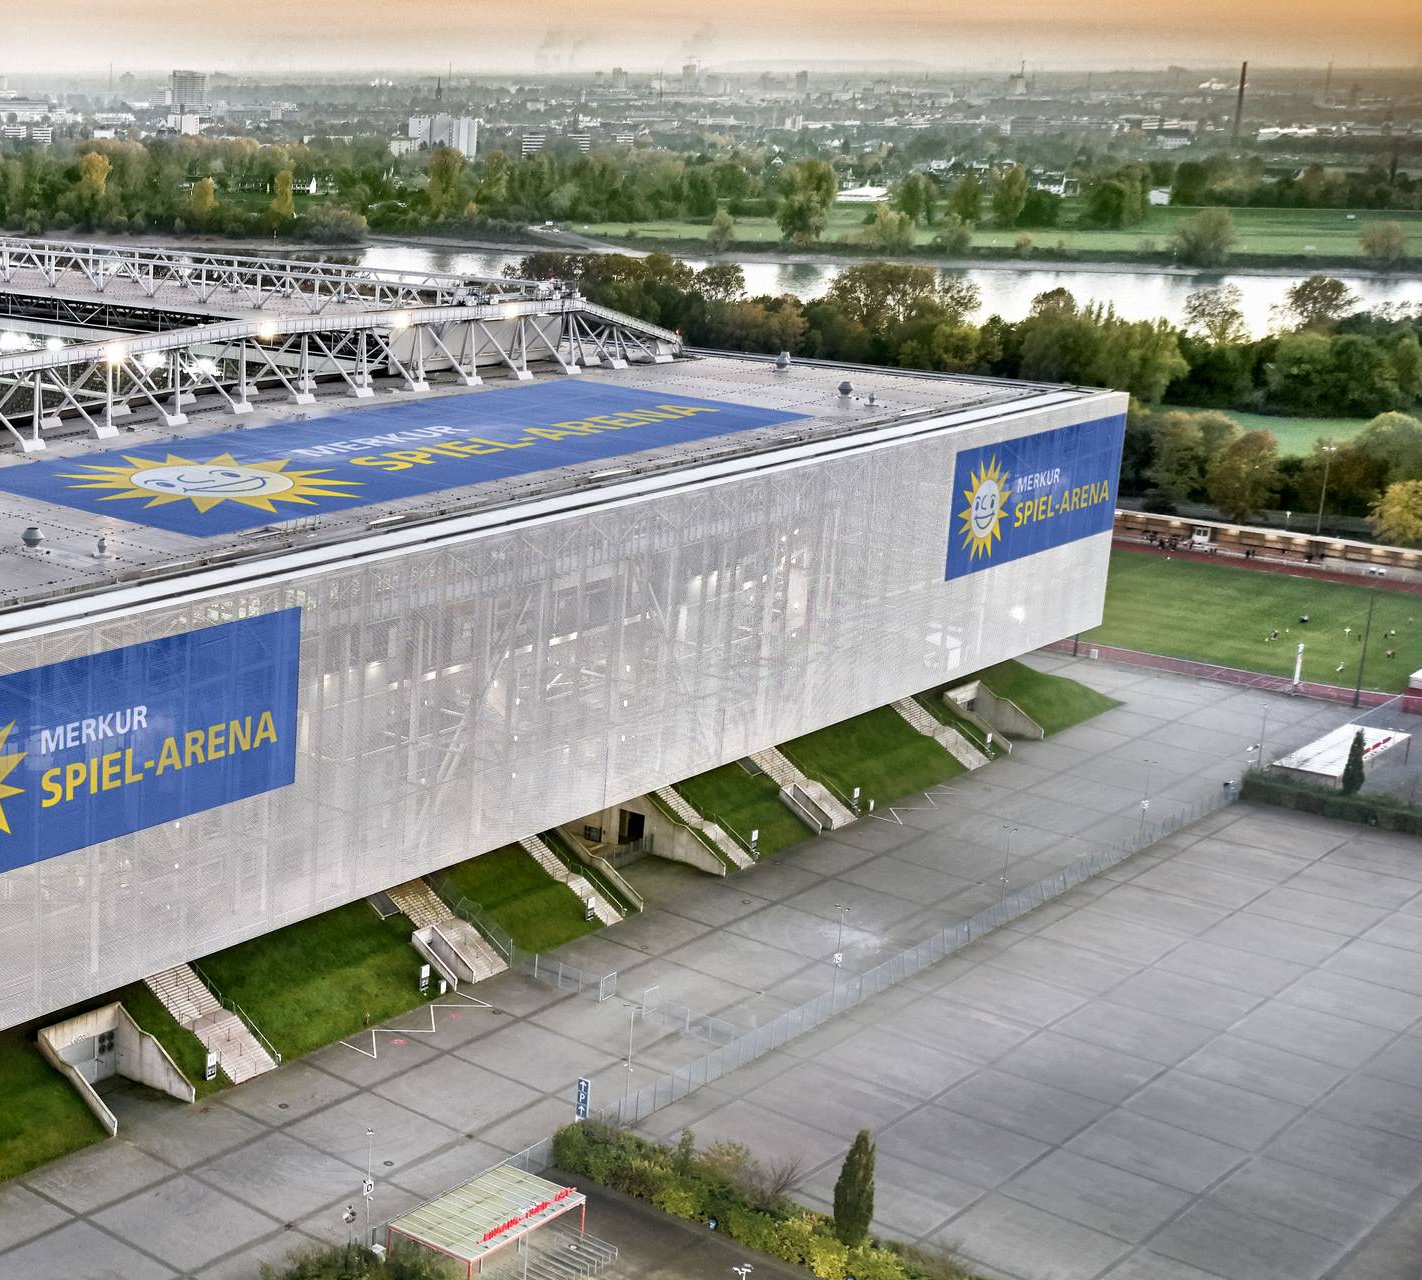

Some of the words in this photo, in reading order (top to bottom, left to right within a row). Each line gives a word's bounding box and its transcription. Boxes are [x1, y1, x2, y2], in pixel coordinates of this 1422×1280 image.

[290, 425, 471, 458] MERKUR
[349, 405, 722, 471] SPIEL-ARENA
[1013, 479, 1110, 528] SPIEL-ARENA
[1017, 468, 1060, 493] MERKUR
[40, 705, 147, 754] MERKUR
[41, 711, 278, 808] SPIEL-ARENA
[579, 1092, 585, 1103] P
